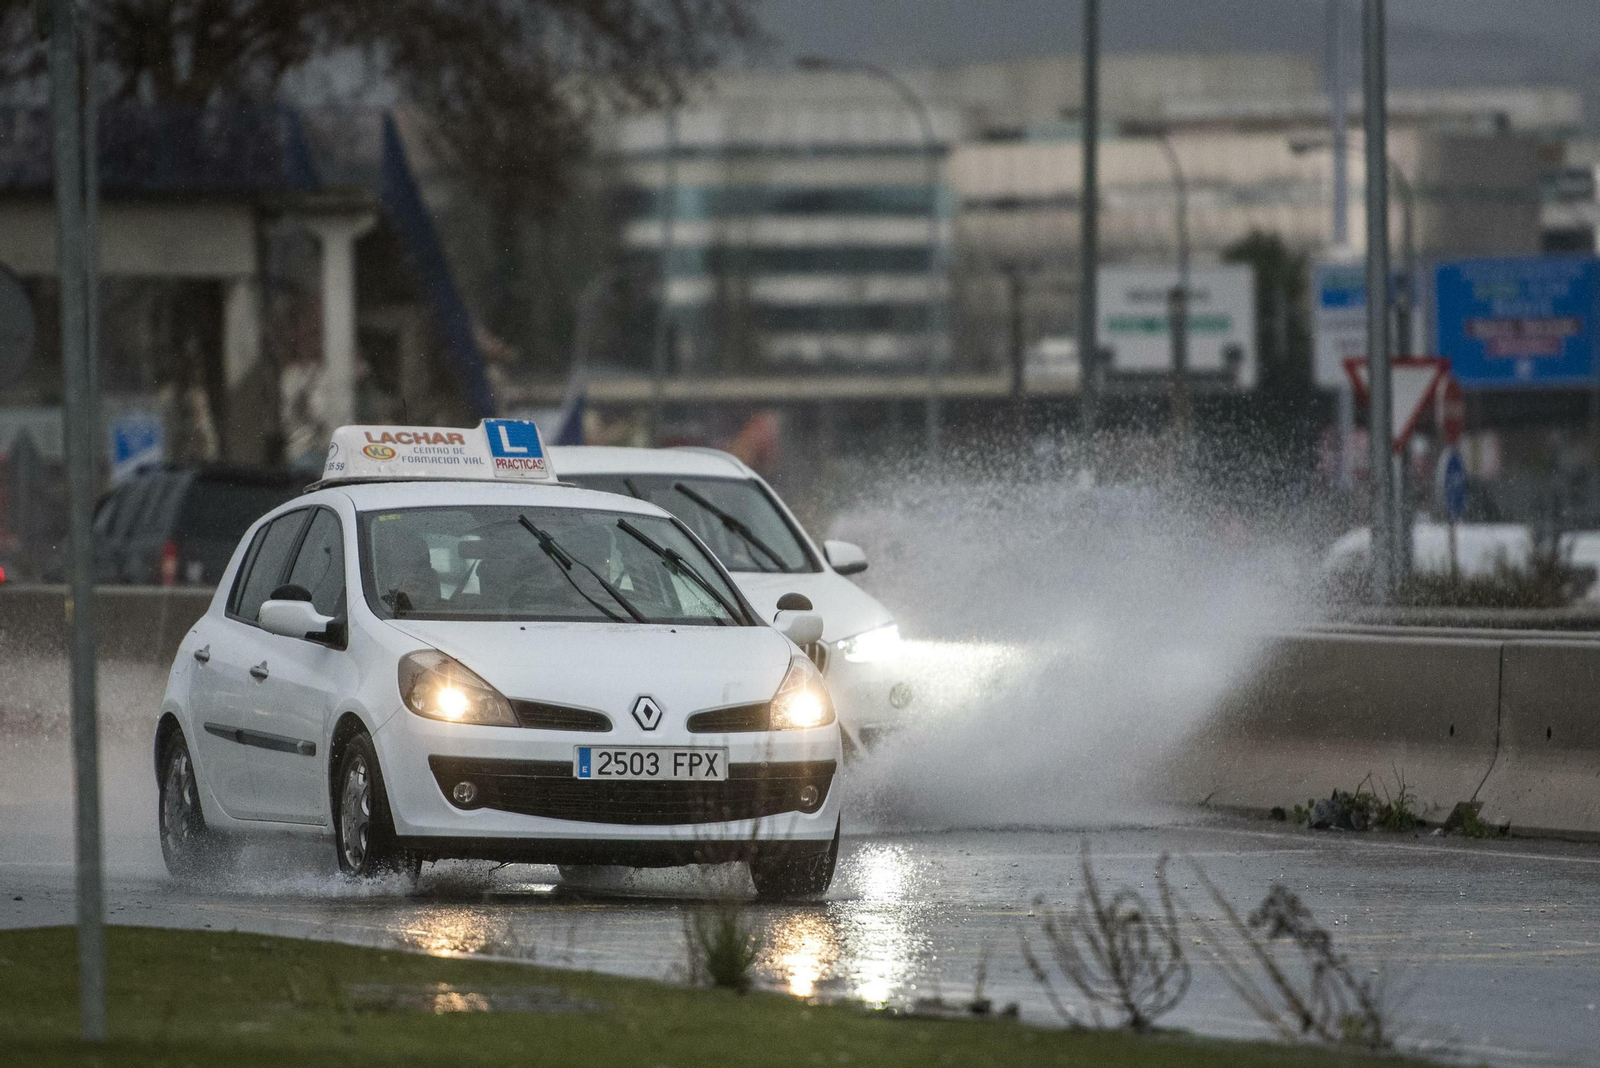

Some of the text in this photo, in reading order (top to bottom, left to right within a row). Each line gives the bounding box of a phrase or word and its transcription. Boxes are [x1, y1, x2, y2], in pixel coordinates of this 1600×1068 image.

[364, 431, 466, 445] LACHAR
[498, 425, 528, 453] L
[413, 446, 465, 455] CENTRO DE
[401, 455, 485, 465] FORMACION VIAL
[495, 458, 544, 470] PRACTICAS
[582, 765, 588, 773] E
[597, 751, 719, 777] 2503 FPX
